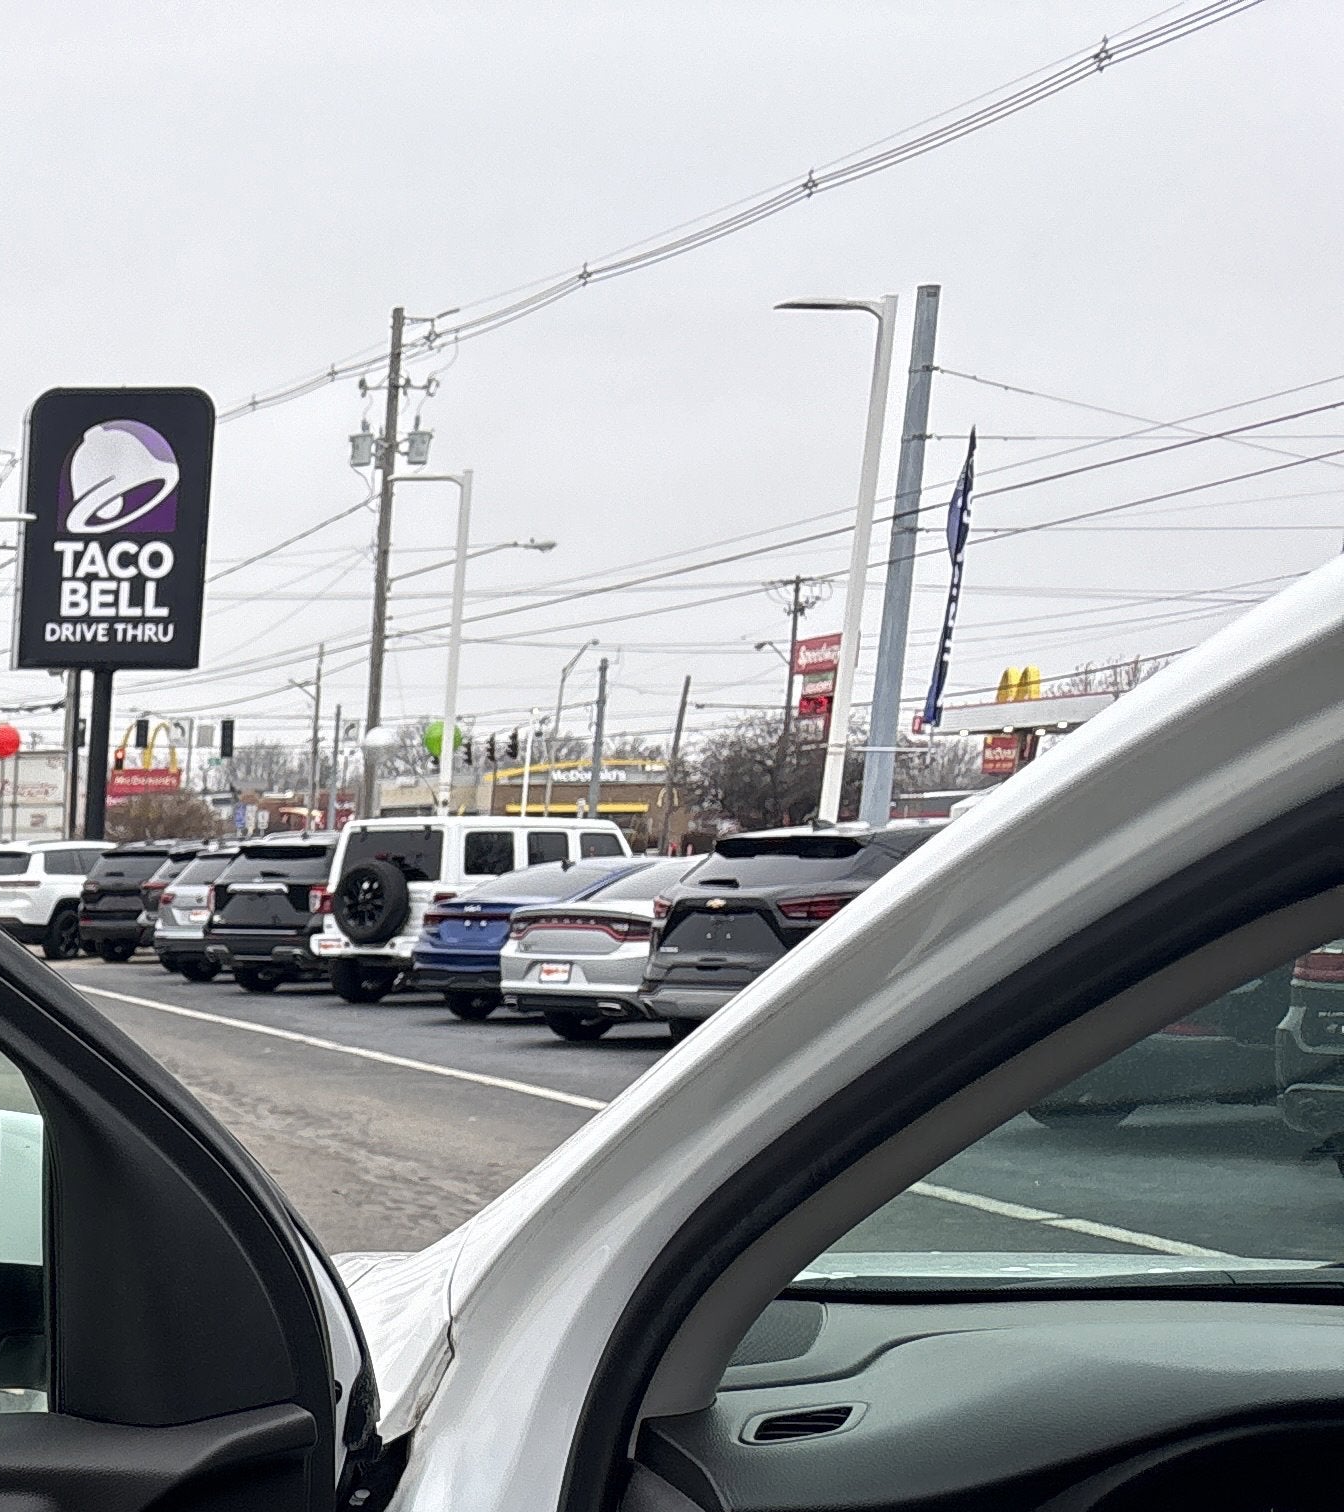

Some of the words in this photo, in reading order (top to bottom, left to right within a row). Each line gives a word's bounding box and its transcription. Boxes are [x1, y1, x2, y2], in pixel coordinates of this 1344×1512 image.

[53, 541, 174, 578] TACO
[60, 581, 169, 617] BELL
[44, 622, 109, 642] DRIVE
[113, 622, 174, 643] THRU
